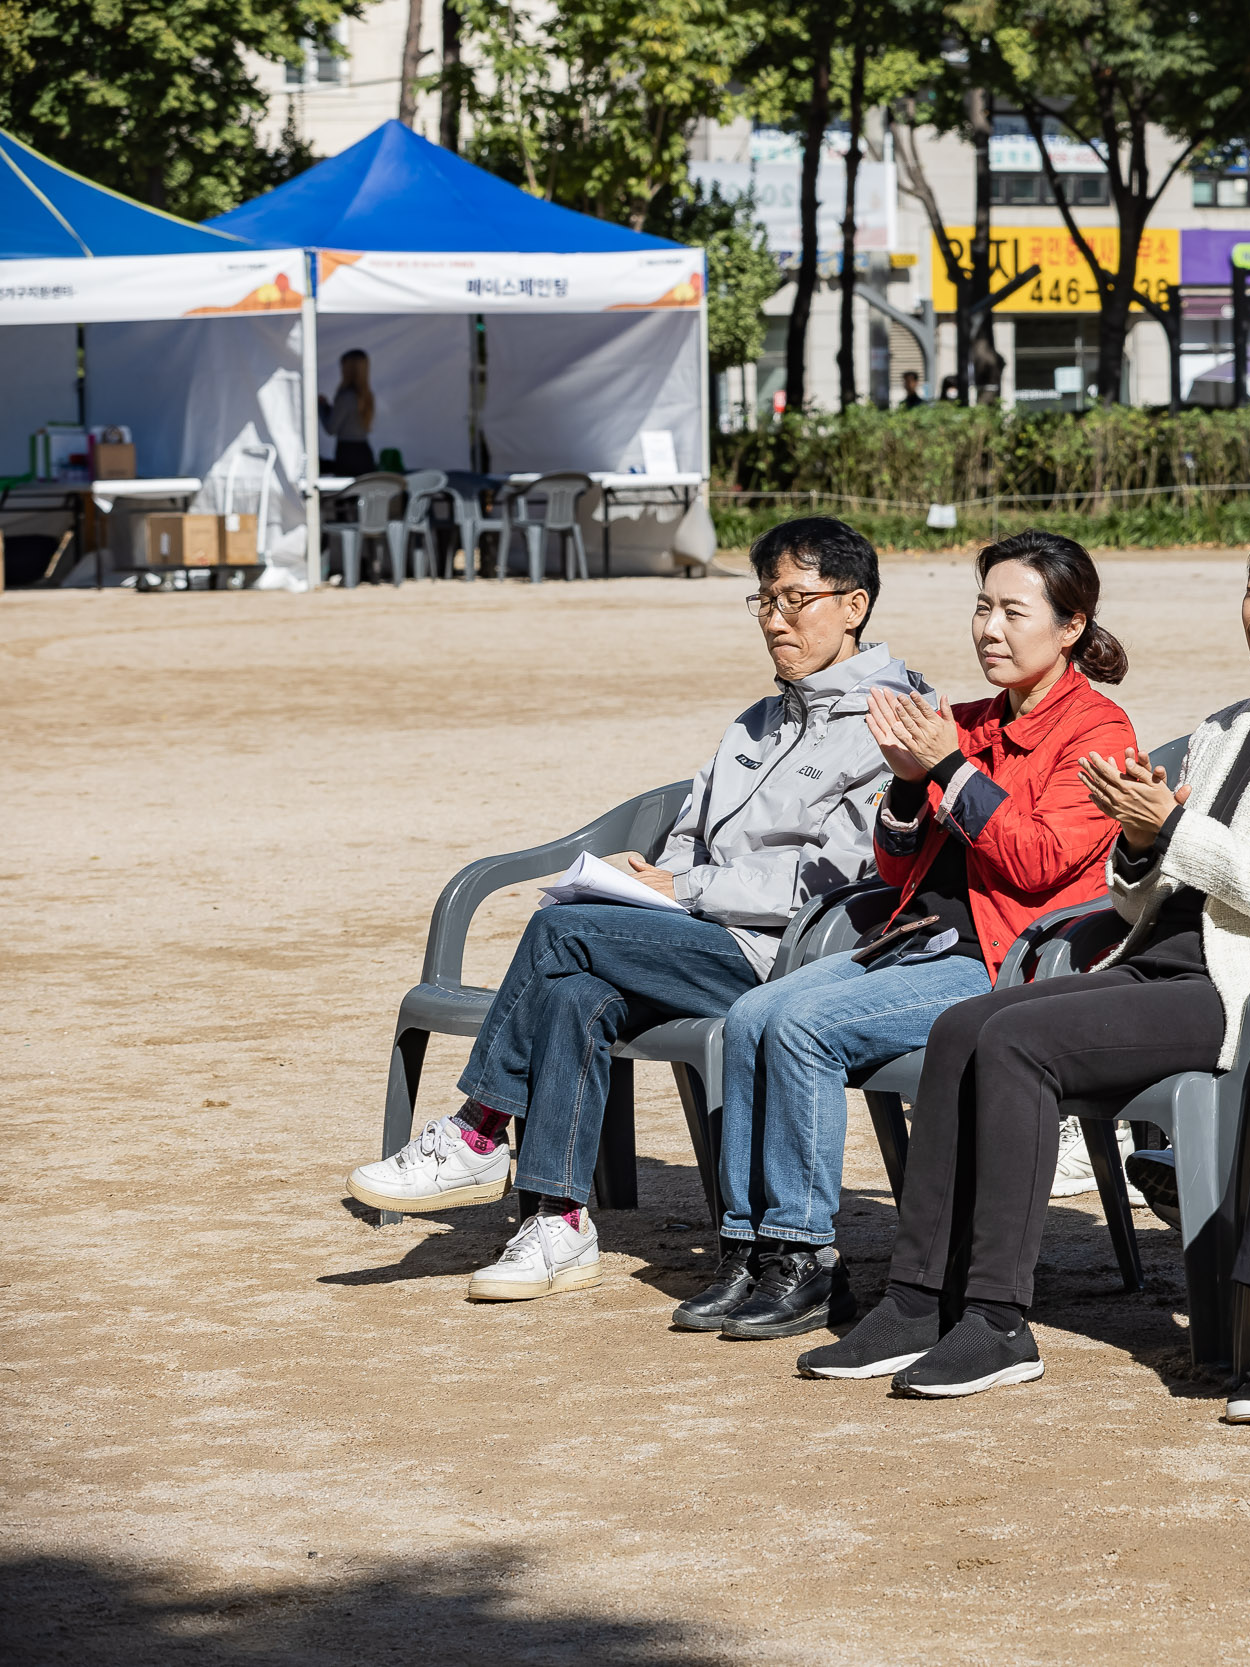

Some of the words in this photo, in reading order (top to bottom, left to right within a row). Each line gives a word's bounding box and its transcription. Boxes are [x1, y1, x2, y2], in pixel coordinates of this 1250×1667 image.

[1029, 236, 1169, 266] 공인중사무소
[466, 277, 568, 297] 페이스페인팅
[1030, 278, 1169, 305] 446-38
[796, 765, 823, 780] EOUL
